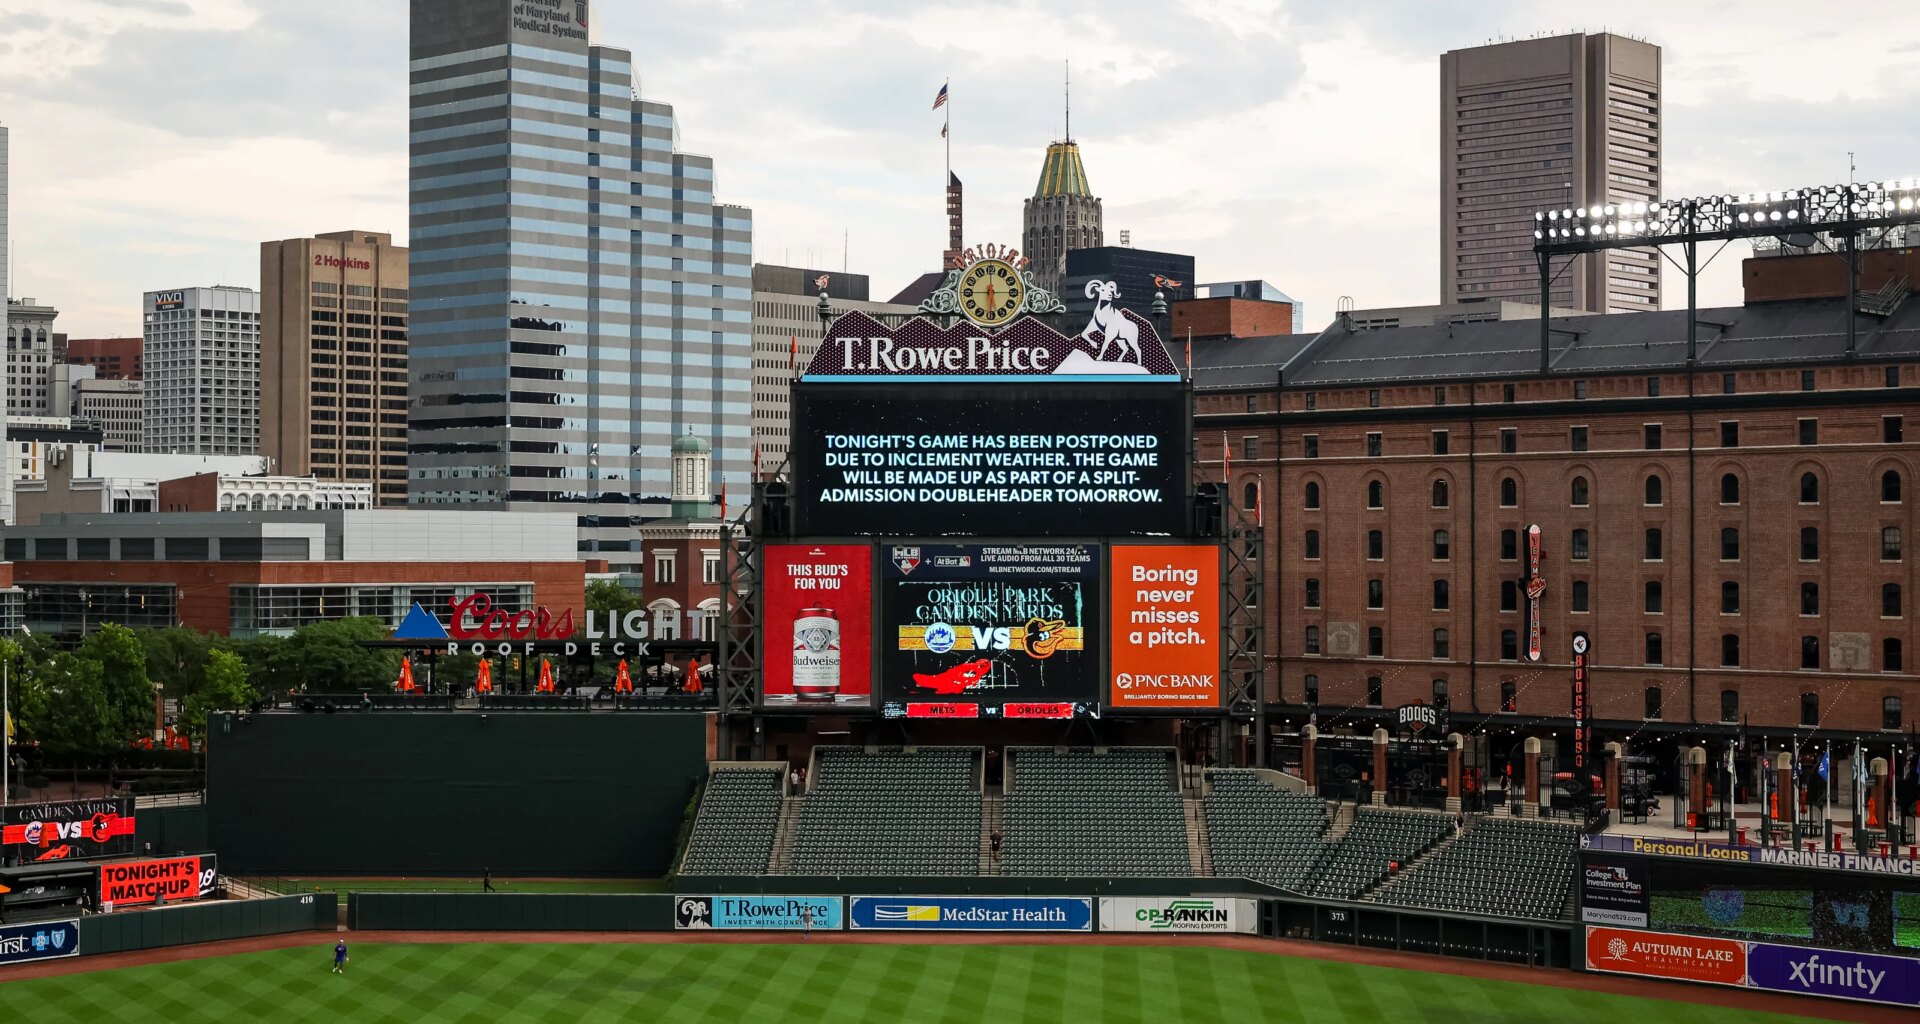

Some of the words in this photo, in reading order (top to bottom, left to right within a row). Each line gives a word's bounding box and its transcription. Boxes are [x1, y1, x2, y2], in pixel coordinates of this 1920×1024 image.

[513, 5, 524, 15] of
[527, 5, 570, 23] Maryland
[513, 17, 550, 34] Medical
[552, 24, 586, 40] System
[315, 254, 322, 266] 2
[324, 254, 370, 270] Hopkins
[953, 243, 1030, 271] ORIOLES
[156, 292, 183, 303] VIVO
[965, 337, 1050, 371] Price
[825, 434, 915, 449] TONIGHT'S
[918, 434, 969, 449] GAME
[972, 434, 1006, 449] HAS
[1009, 434, 1052, 449] BEEN
[1056, 434, 1158, 449] POSTPONED
[825, 452, 859, 467] DUE
[861, 452, 885, 467] TO
[888, 452, 983, 467] INCLEMENT
[985, 452, 1070, 467] WEATHER.
[1073, 452, 1105, 467] THE
[1108, 452, 1158, 467] GAME
[843, 470, 881, 485] WILL
[884, 470, 905, 485] BE
[908, 470, 957, 485] MADE
[960, 470, 982, 485] UP
[985, 470, 1006, 485] AS
[1010, 470, 1049, 485] PART
[1052, 470, 1076, 485] OF
[1078, 470, 1090, 485] A
[1093, 470, 1140, 485] SPLIT-
[820, 488, 915, 502] ADMISSION
[919, 488, 1053, 502] DOUBLEHEADER
[1055, 488, 1162, 503] TOMORROW.
[982, 547, 1012, 555] STREAM
[1029, 547, 1065, 555] NETWORK
[1531, 536, 1539, 574] TEAM
[787, 564, 812, 576] THIS
[989, 566, 1081, 574] MLBNETWORK.COM/STREAM
[1132, 565, 1198, 586] Boring
[794, 578, 816, 589] FOR
[818, 578, 841, 589] YOU
[928, 588, 998, 603] ORIOLE
[1005, 588, 1053, 603] PARK
[1136, 589, 1195, 603] never
[448, 592, 576, 640] Coors
[586, 609, 705, 641] LIGHT
[1003, 604, 1063, 620] YARDS
[1131, 606, 1200, 624] misses
[1531, 600, 1539, 649] STORE
[973, 627, 1010, 650] VS
[1129, 631, 1143, 644] a
[1148, 627, 1206, 648] pitch.
[448, 642, 535, 656] ROOF
[566, 642, 650, 656] DECK
[1135, 675, 1168, 687] PNC
[1170, 675, 1213, 687] BANK
[929, 706, 955, 714] METS
[1017, 706, 1059, 714] ORIOLES
[19, 807, 74, 822] CAMDEN
[79, 802, 117, 814] YARDS
[57, 821, 82, 839] VS
[1633, 838, 1698, 857] Personal
[1703, 844, 1749, 861] Loans
[1761, 848, 1841, 869] MARINER
[1844, 854, 1920, 876] FINANCE
[1585, 869, 1612, 880] College
[110, 879, 191, 900] MATCHUP
[1586, 878, 1625, 889] Investment
[1625, 881, 1642, 890] Plan
[300, 895, 314, 904] 410
[943, 907, 1009, 921] MedStar
[1012, 907, 1066, 921] Health
[1331, 912, 1345, 921] 373
[1586, 911, 1642, 923] Maryland529.com
[1632, 942, 1693, 958] AUTUMN
[1697, 948, 1734, 962] LAKE
[1645, 956, 1720, 969] HEALTHCARE
[1789, 955, 1886, 994] xfinity
